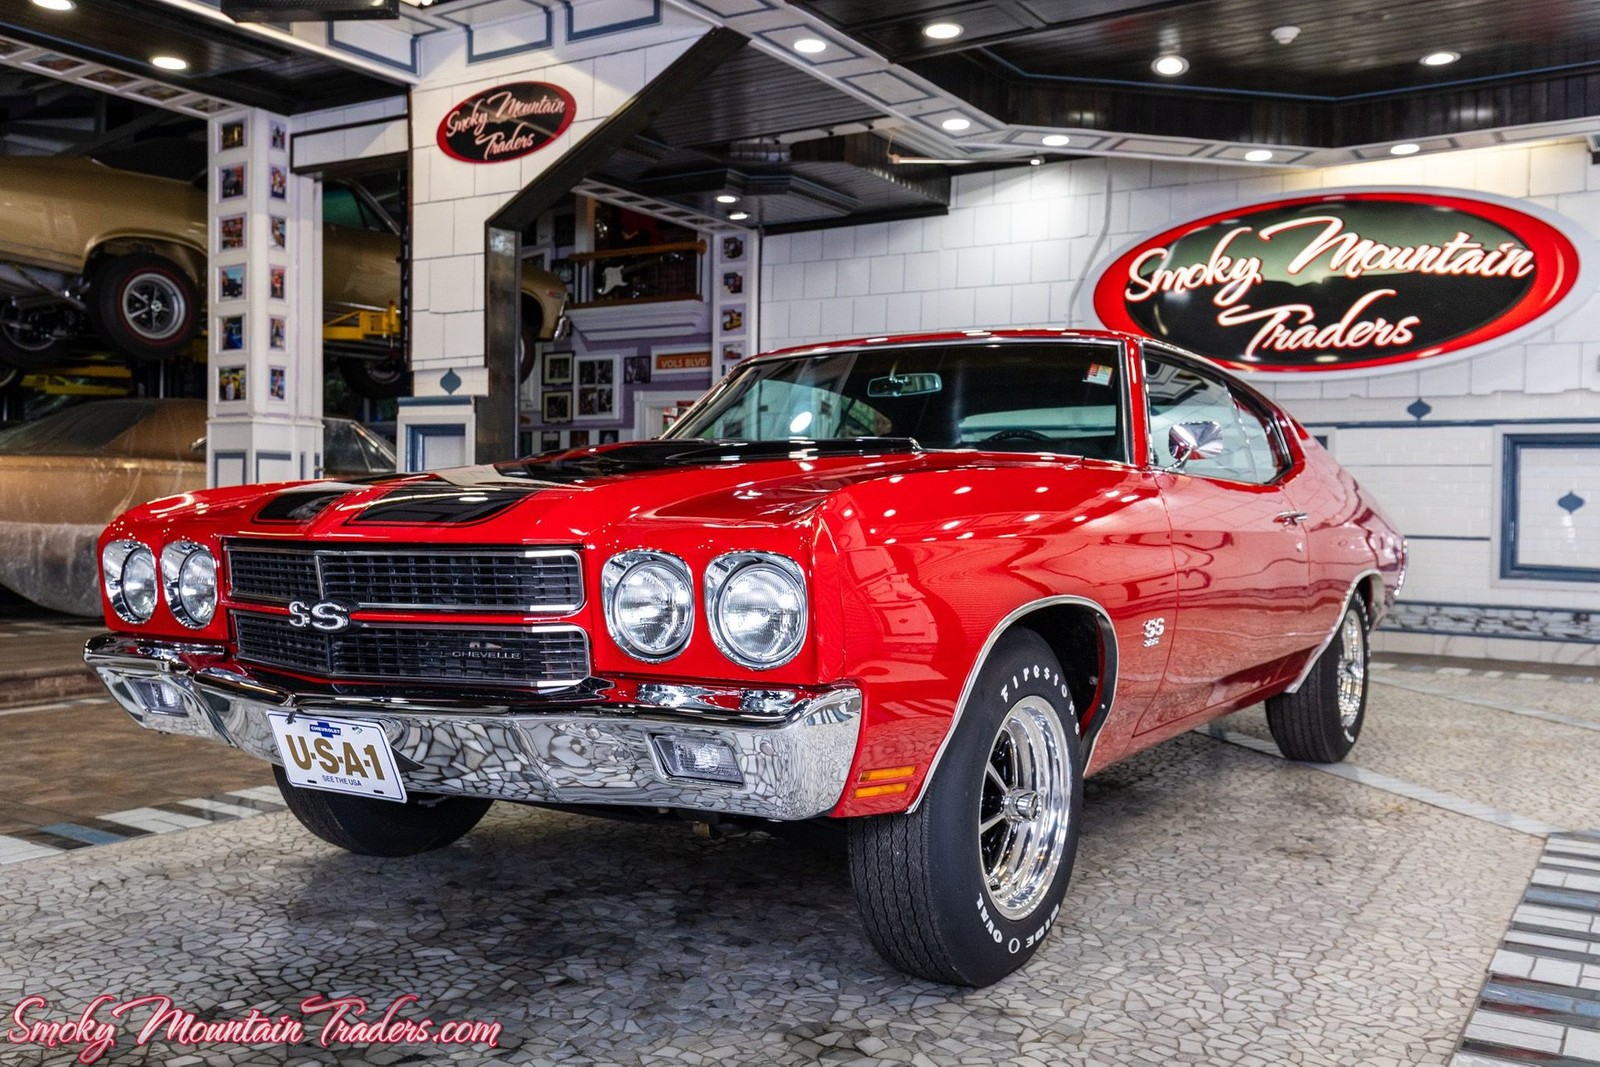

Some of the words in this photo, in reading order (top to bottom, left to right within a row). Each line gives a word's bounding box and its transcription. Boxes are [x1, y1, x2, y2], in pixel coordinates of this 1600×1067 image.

[446, 98, 488, 137] Smoky
[487, 91, 566, 119] Mountain
[475, 121, 536, 160] Traders
[1124, 226, 1263, 309] Smoky
[1258, 214, 1536, 282] Mountain
[1217, 288, 1421, 363] Traders
[661, 358, 683, 369] VOLS
[685, 357, 707, 367] BLVD
[288, 601, 349, 630] SS
[1141, 617, 1165, 638] SS
[452, 650, 520, 660] CHEVELLE
[311, 725, 341, 735] CHEVROLET
[322, 774, 336, 784] SEE
[336, 776, 349, 785] THE
[348, 778, 363, 787] USA
